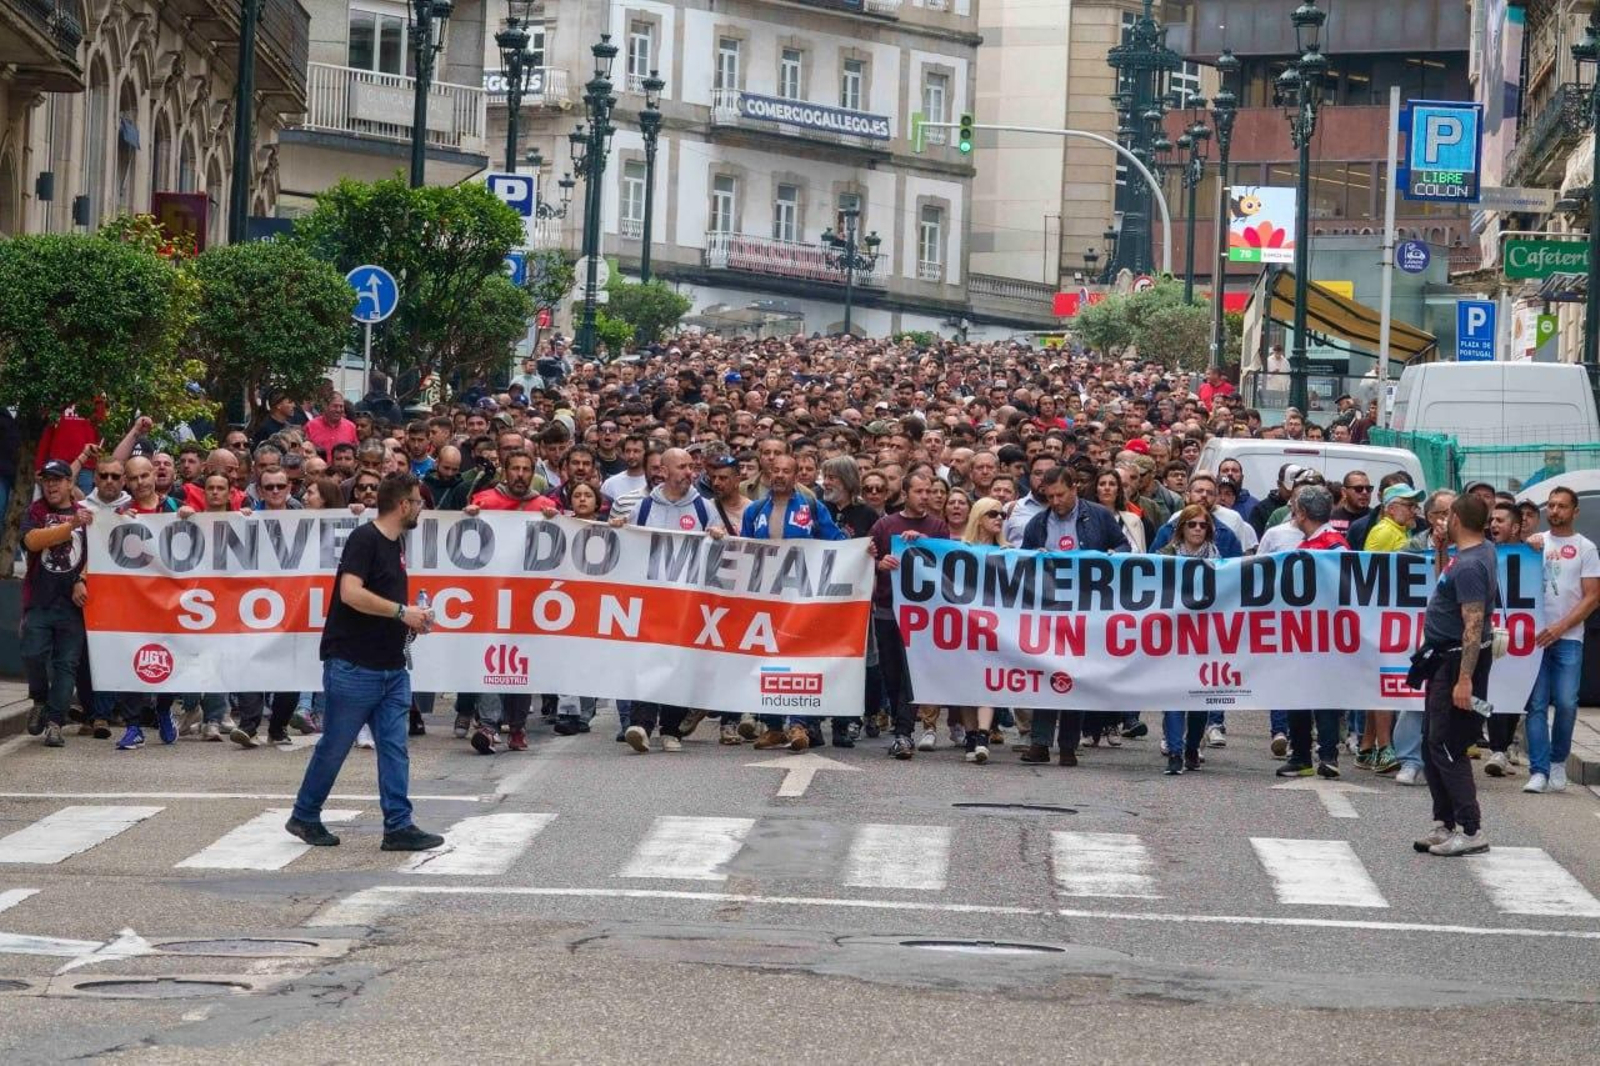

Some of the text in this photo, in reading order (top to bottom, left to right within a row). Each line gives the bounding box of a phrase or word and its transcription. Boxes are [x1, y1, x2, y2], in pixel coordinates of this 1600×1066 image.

[746, 99, 889, 136] COMERCIOGALLEGO.ES
[1425, 115, 1463, 164] P
[494, 178, 528, 203] P
[1414, 183, 1469, 197] COLON
[1422, 171, 1464, 185] LIBRE
[1467, 306, 1487, 336] P
[1459, 349, 1492, 358] PORTUGAL
[1460, 340, 1491, 349] PLAZA DE
[108, 517, 853, 598] CONVEIO DO METAL
[900, 547, 1536, 612] COMERCIO DO MEL
[177, 581, 780, 653] SOLCIÓN XA
[899, 604, 1536, 657] POR UN CONVENIO DIO
[139, 650, 169, 667] UGT
[484, 644, 529, 675] CIG
[484, 676, 528, 685] INDUSTRIA
[764, 676, 819, 691] CCOO
[985, 667, 1045, 693] UGT
[1199, 661, 1242, 687] CIG
[761, 693, 821, 708] industria
